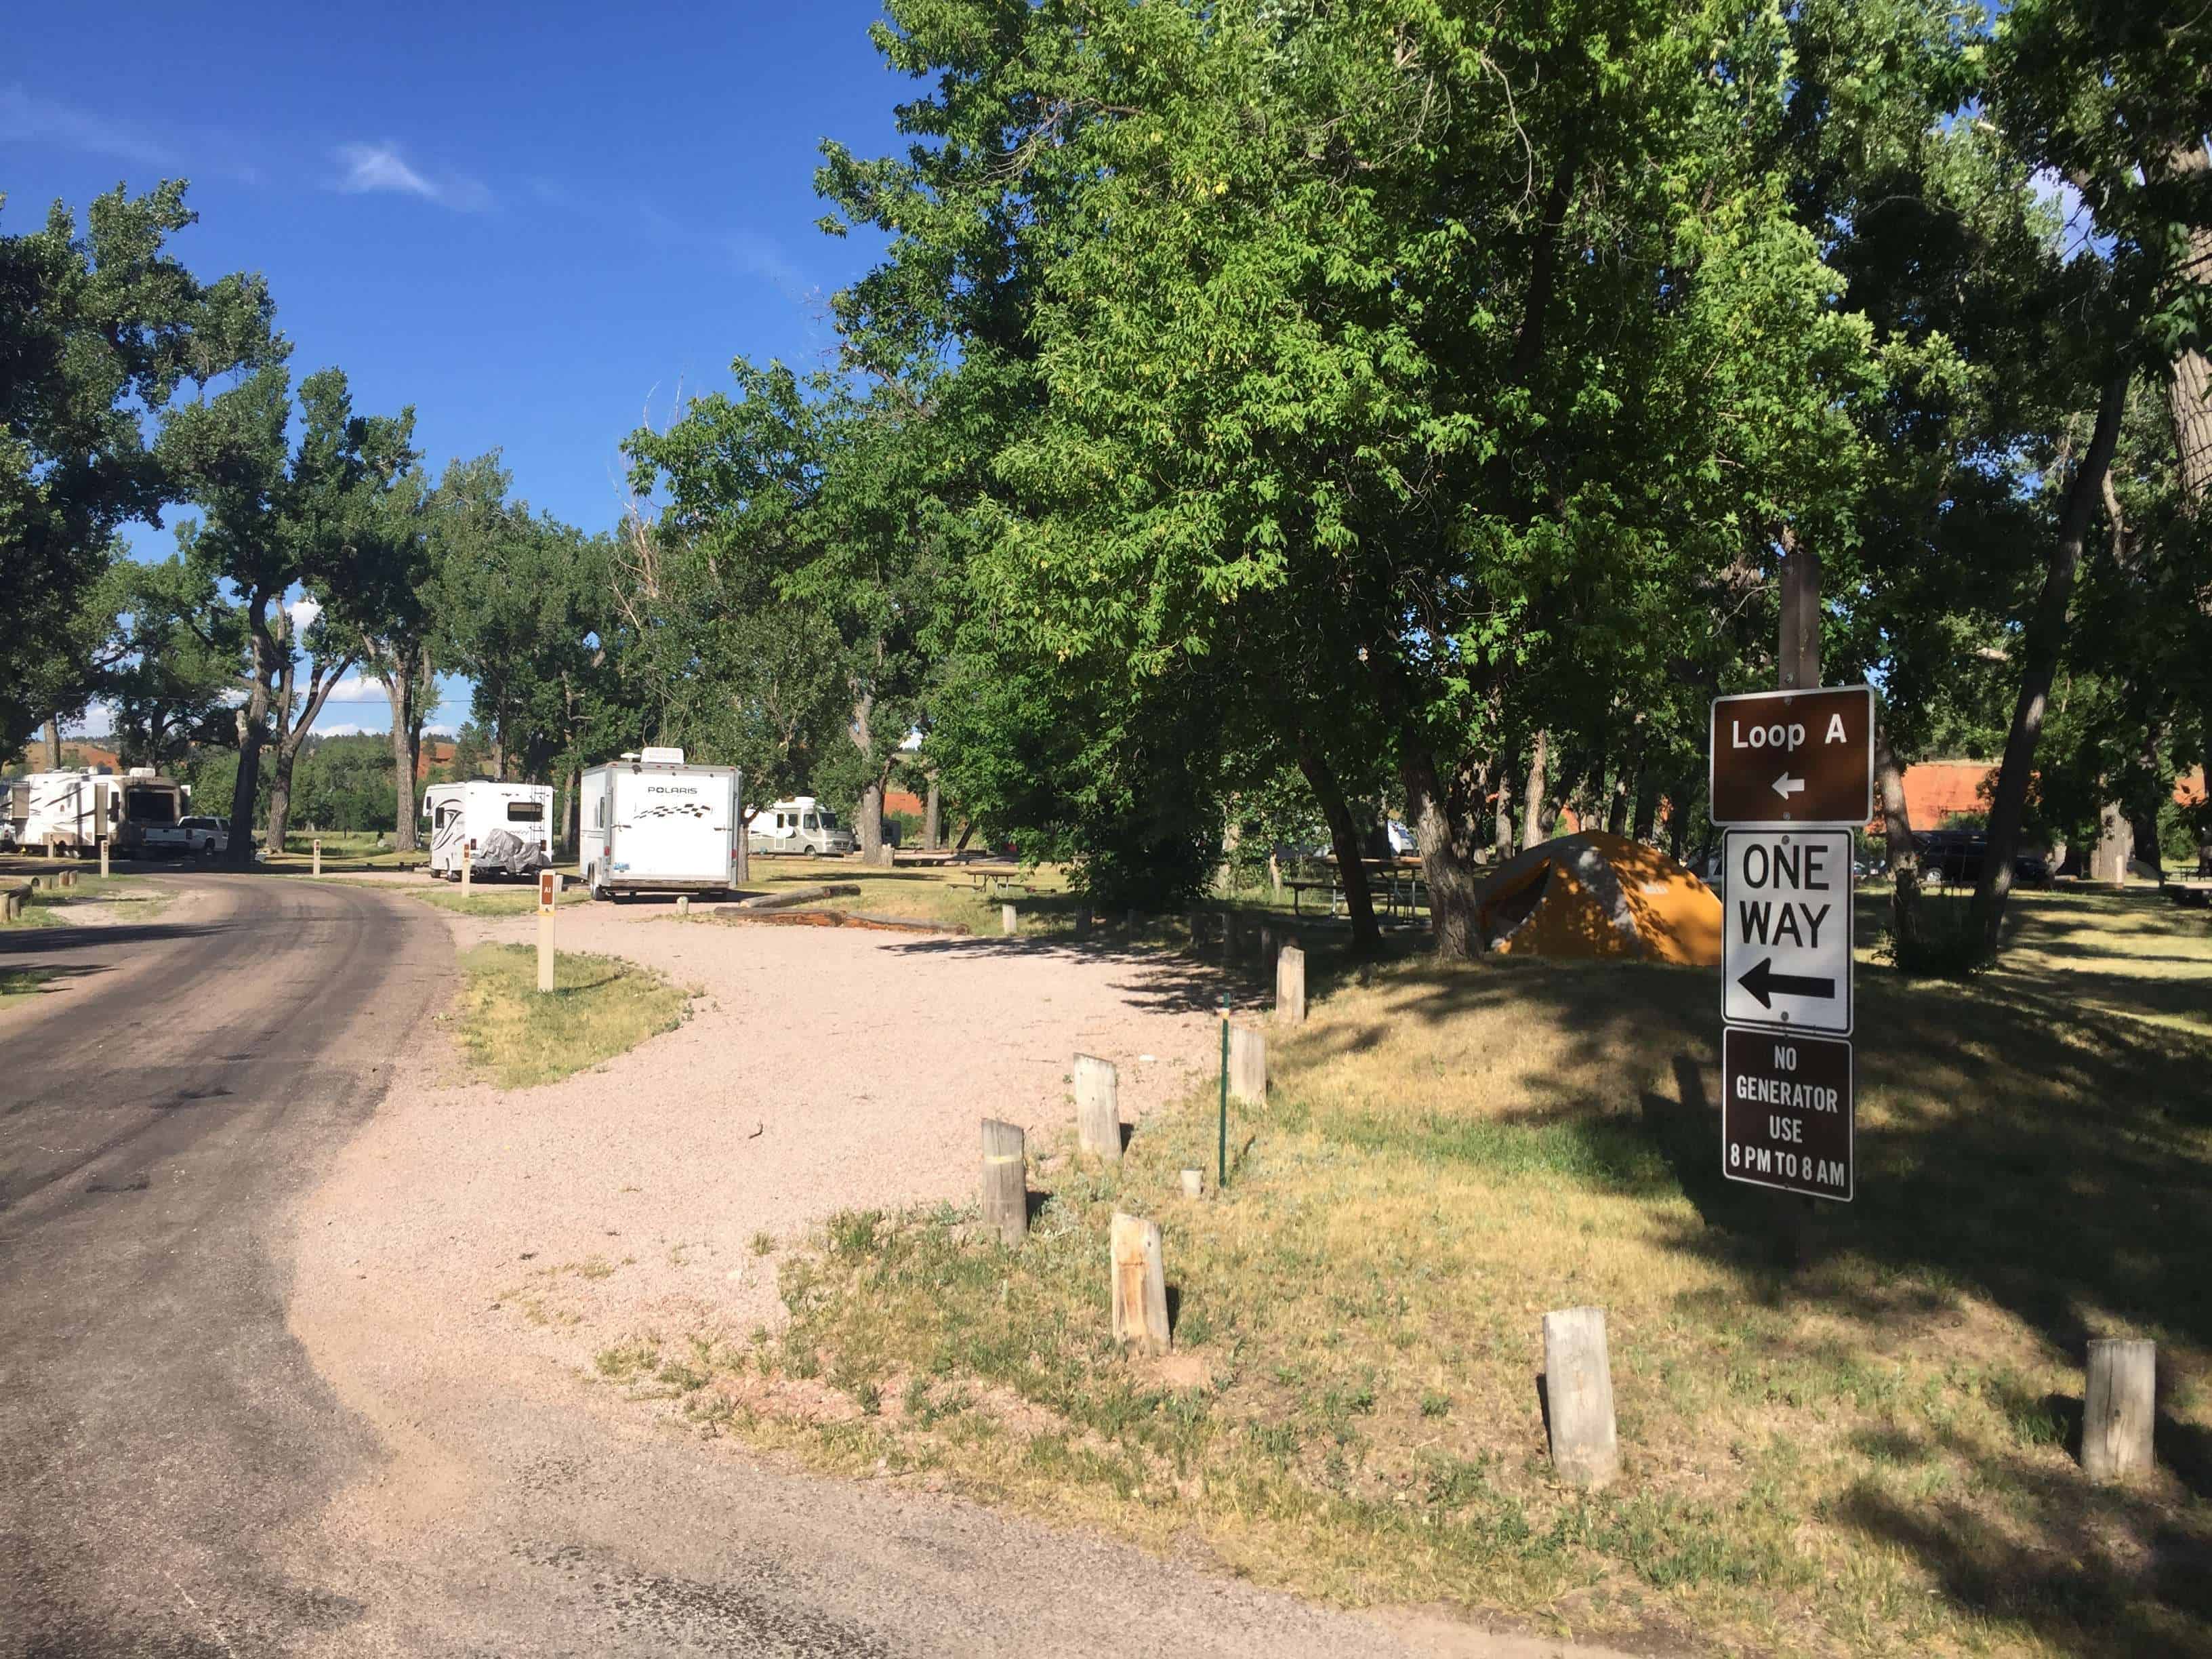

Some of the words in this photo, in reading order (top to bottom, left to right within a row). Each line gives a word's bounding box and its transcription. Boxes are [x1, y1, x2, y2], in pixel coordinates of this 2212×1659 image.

[1732, 720, 1805, 752] Loop
[1824, 713, 1847, 744] A
[648, 786, 698, 794] POLARIS
[1743, 843, 1830, 891] ONE
[1739, 900, 1832, 949] WAY
[1774, 1044, 1797, 1071] NO
[1736, 1074, 1839, 1113] GENERATOR
[1769, 1115, 1803, 1144] USE
[1730, 1142, 1741, 1168] 8
[1744, 1145, 1771, 1174] PM
[1775, 1151, 1797, 1178] TO
[1801, 1156, 1813, 1181] 8
[1816, 1160, 1845, 1187] AM
